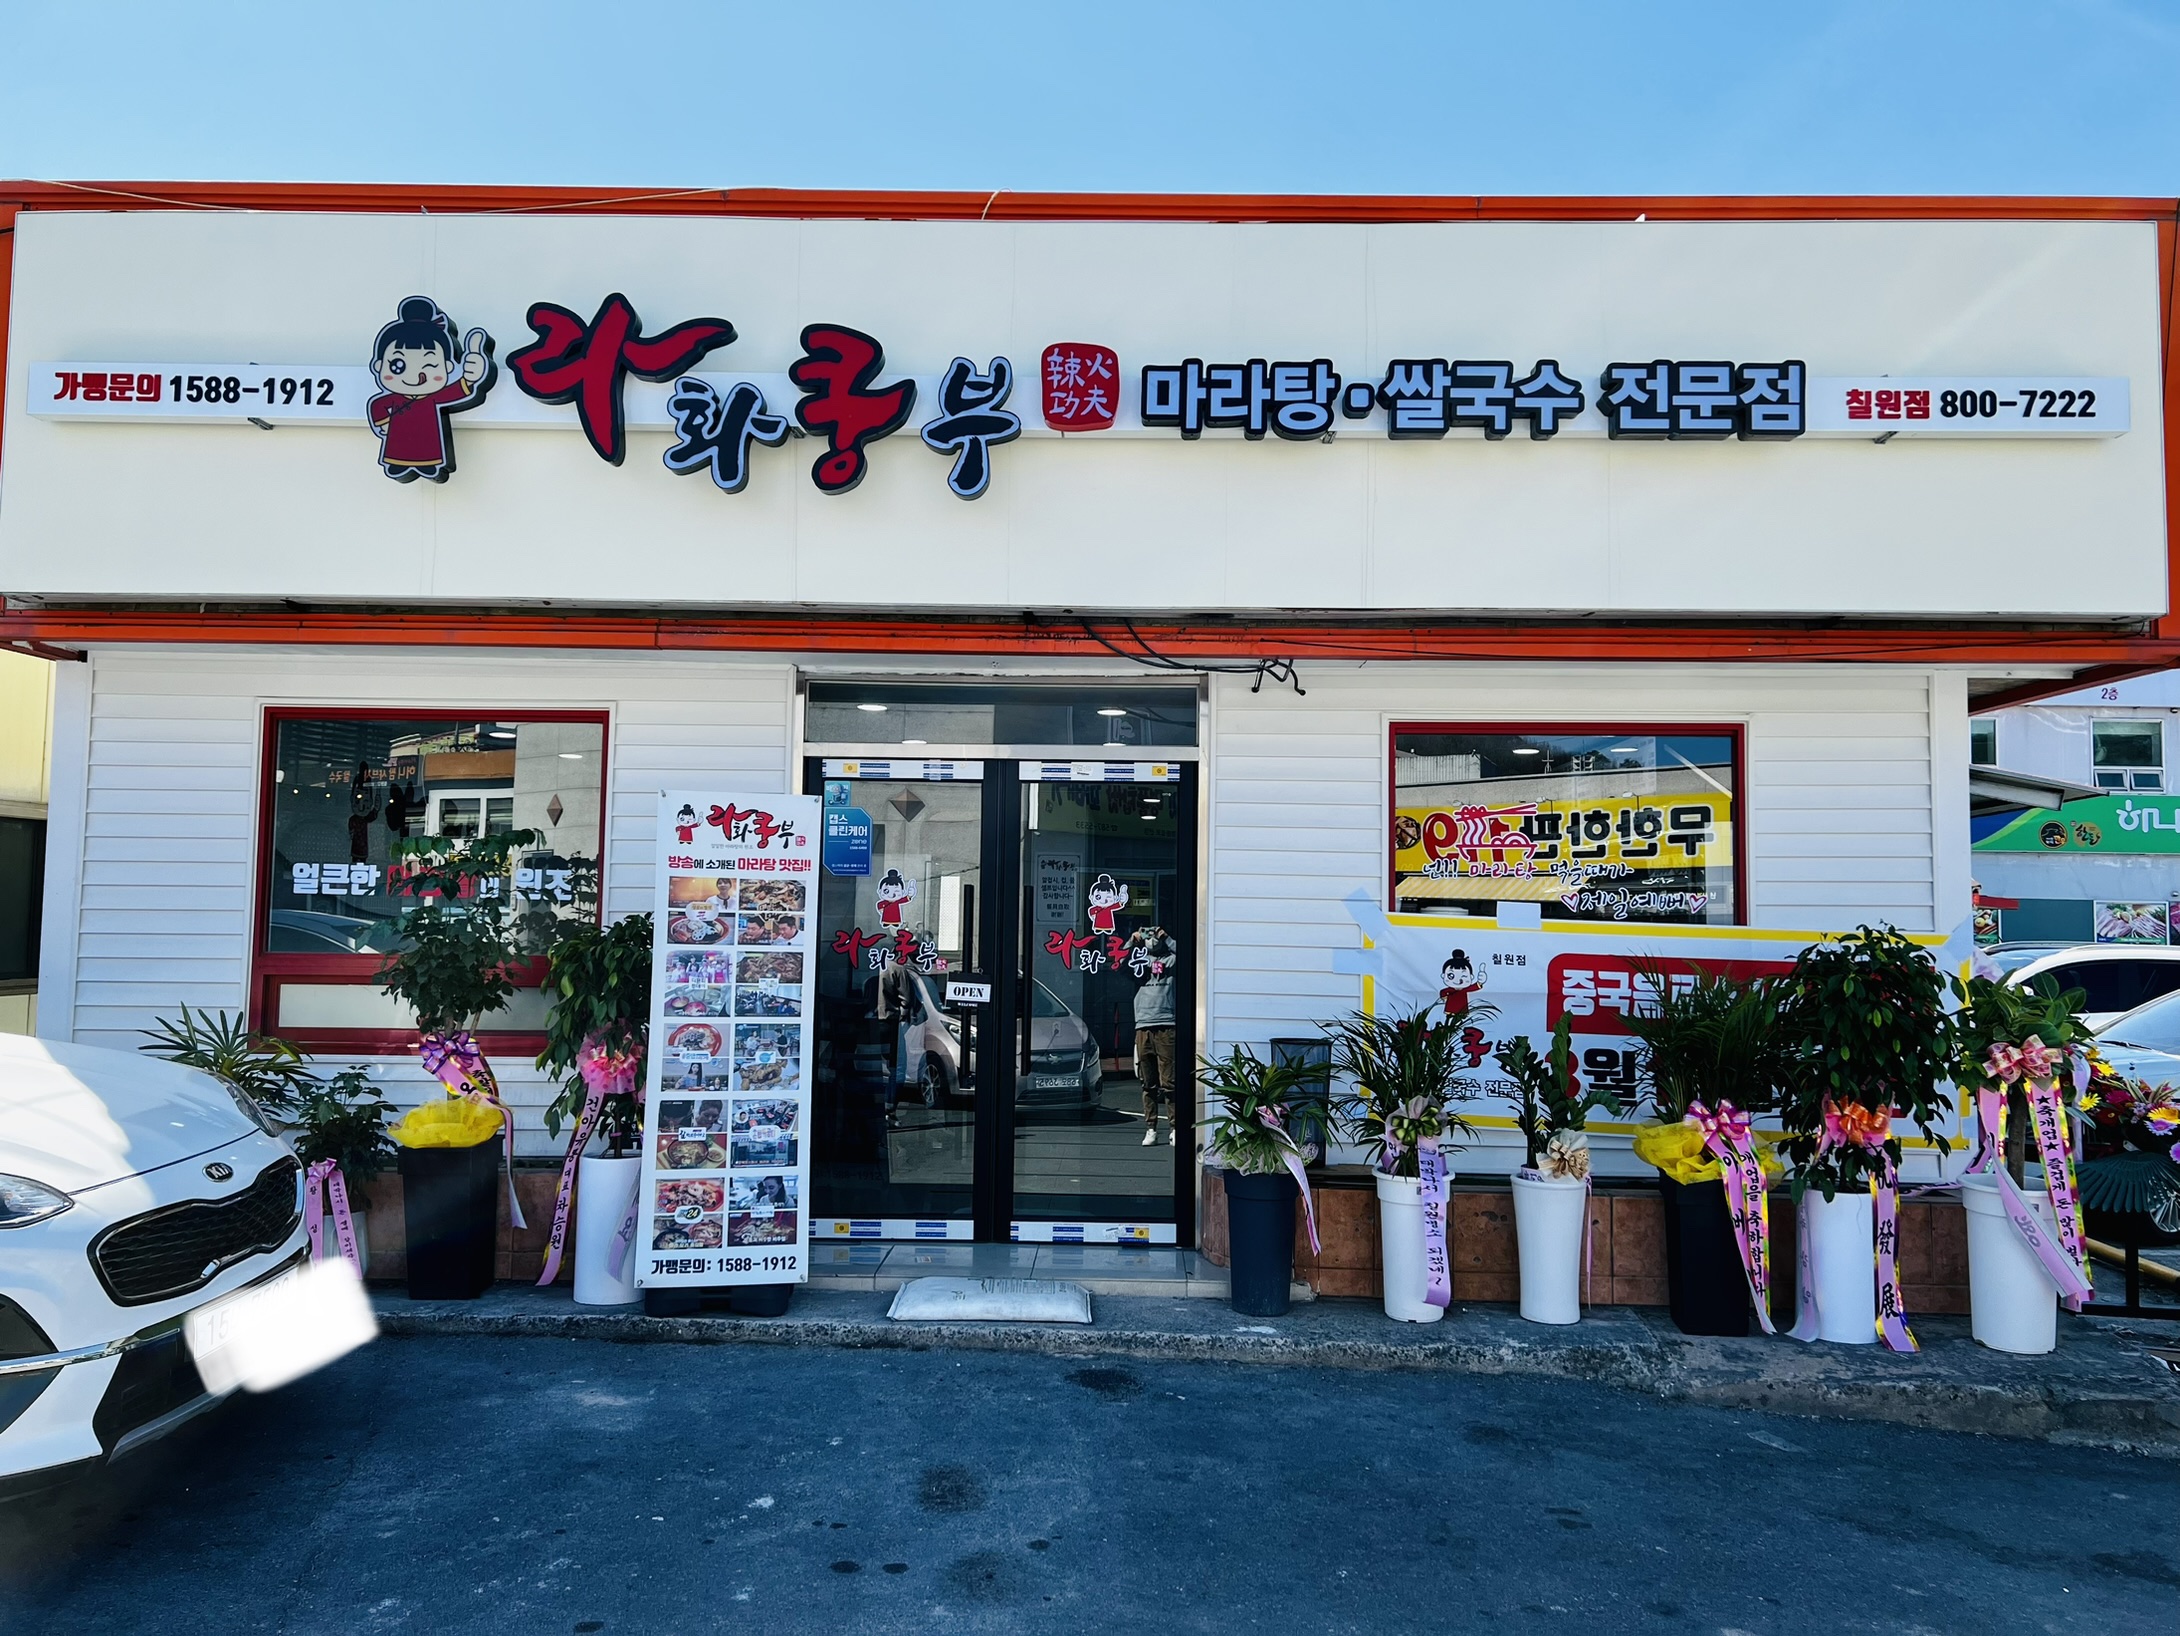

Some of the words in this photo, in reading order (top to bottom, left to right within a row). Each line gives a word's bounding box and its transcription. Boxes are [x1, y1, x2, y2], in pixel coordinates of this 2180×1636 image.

[170, 375, 334, 406] 1588-1912
[506, 293, 1021, 500] 라화쿵부
[1599, 359, 1806, 441] 전문점
[1845, 388, 1931, 420] 칠원점
[1940, 389, 2097, 419] 800-7222
[2101, 687, 2119, 701] 2층
[706, 803, 795, 849] 라화쿵부
[829, 813, 848, 824] 캡스
[829, 825, 868, 836] 클린케어
[668, 855, 704, 870] 방송에
[706, 859, 735, 870] 소개된
[737, 858, 776, 872] 마라탕
[779, 858, 811, 872] 맛집!!
[1469, 861, 1538, 881] 마라탕
[292, 862, 381, 896] 얼큰한
[831, 927, 938, 973] 라화쿵부
[1043, 928, 1150, 978] 라화쿵부
[1492, 953, 1527, 966] 칠원점
[953, 986, 984, 998] OPEN
[2047, 1157, 2066, 1192] 즐겁게
[2056, 1197, 2071, 1209] 돈
[717, 1256, 796, 1273] 1588-1912
